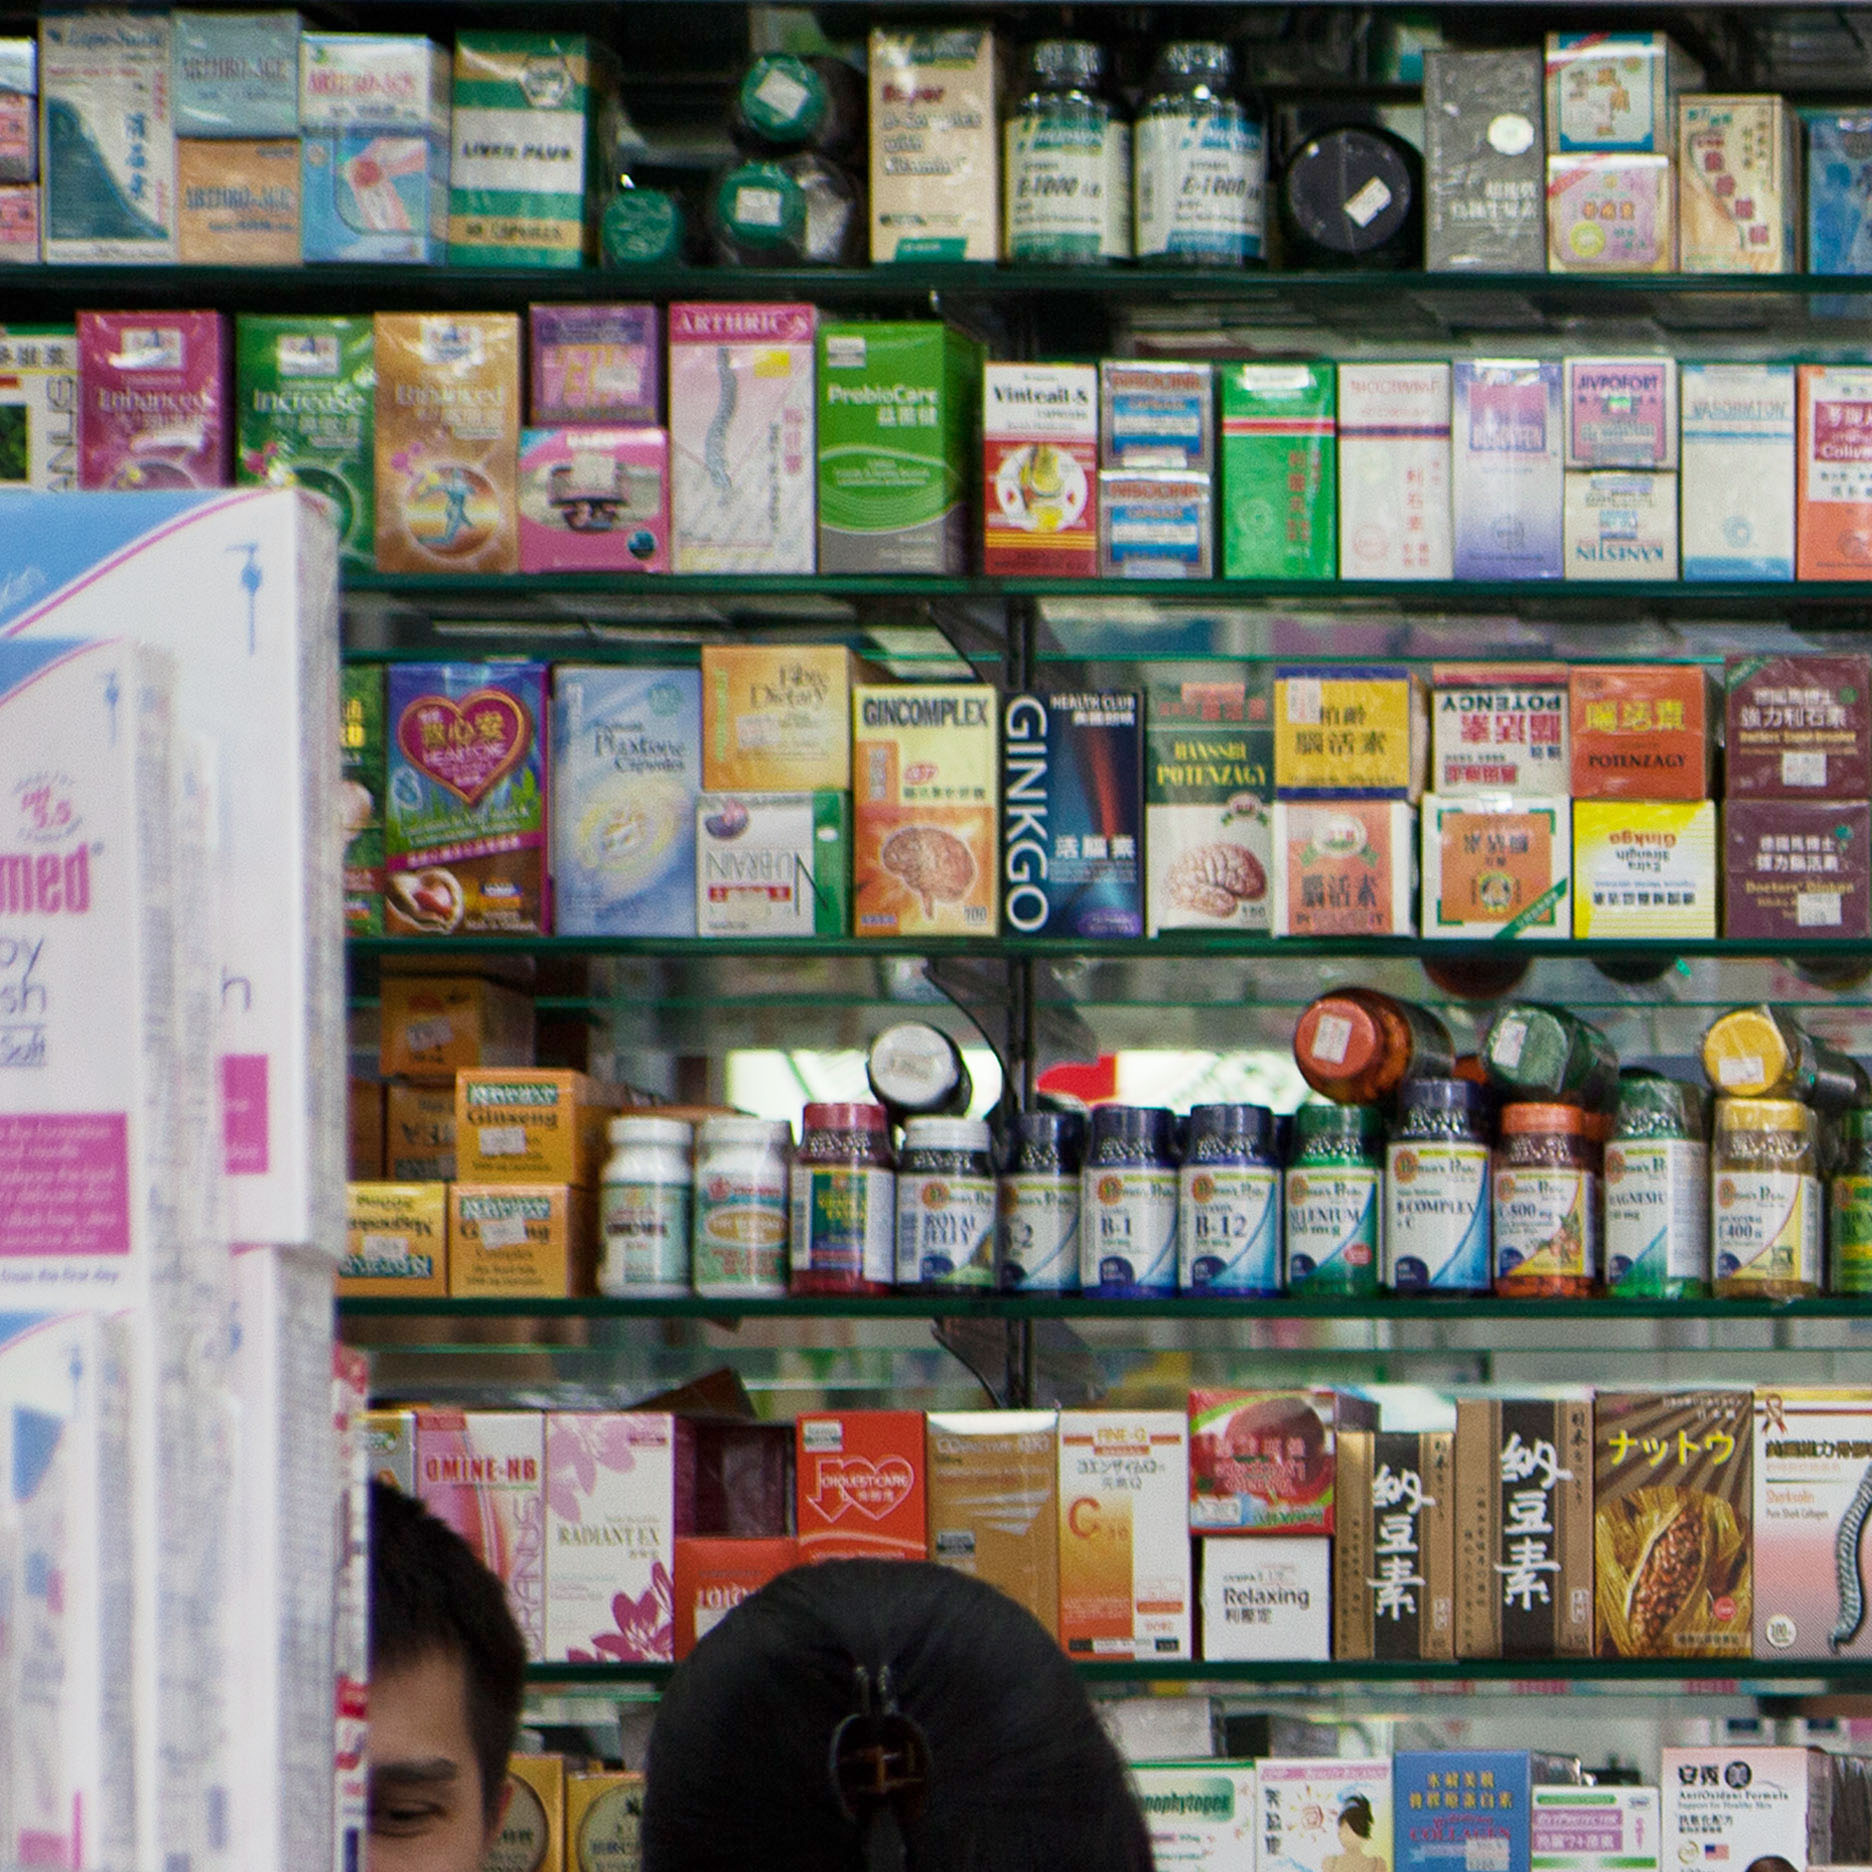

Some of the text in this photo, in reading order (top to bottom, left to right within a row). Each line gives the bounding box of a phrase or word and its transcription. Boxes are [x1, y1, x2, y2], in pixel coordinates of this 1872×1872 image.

[828, 386, 939, 405] ProbioCare
[864, 701, 988, 726] GINCOMPLEX
[1442, 695, 1562, 711] POTENCY
[1006, 696, 1049, 931] GINKGO
[1609, 1430, 1735, 1465] ナットウ
[1223, 1586, 1309, 1609] Relaxing
